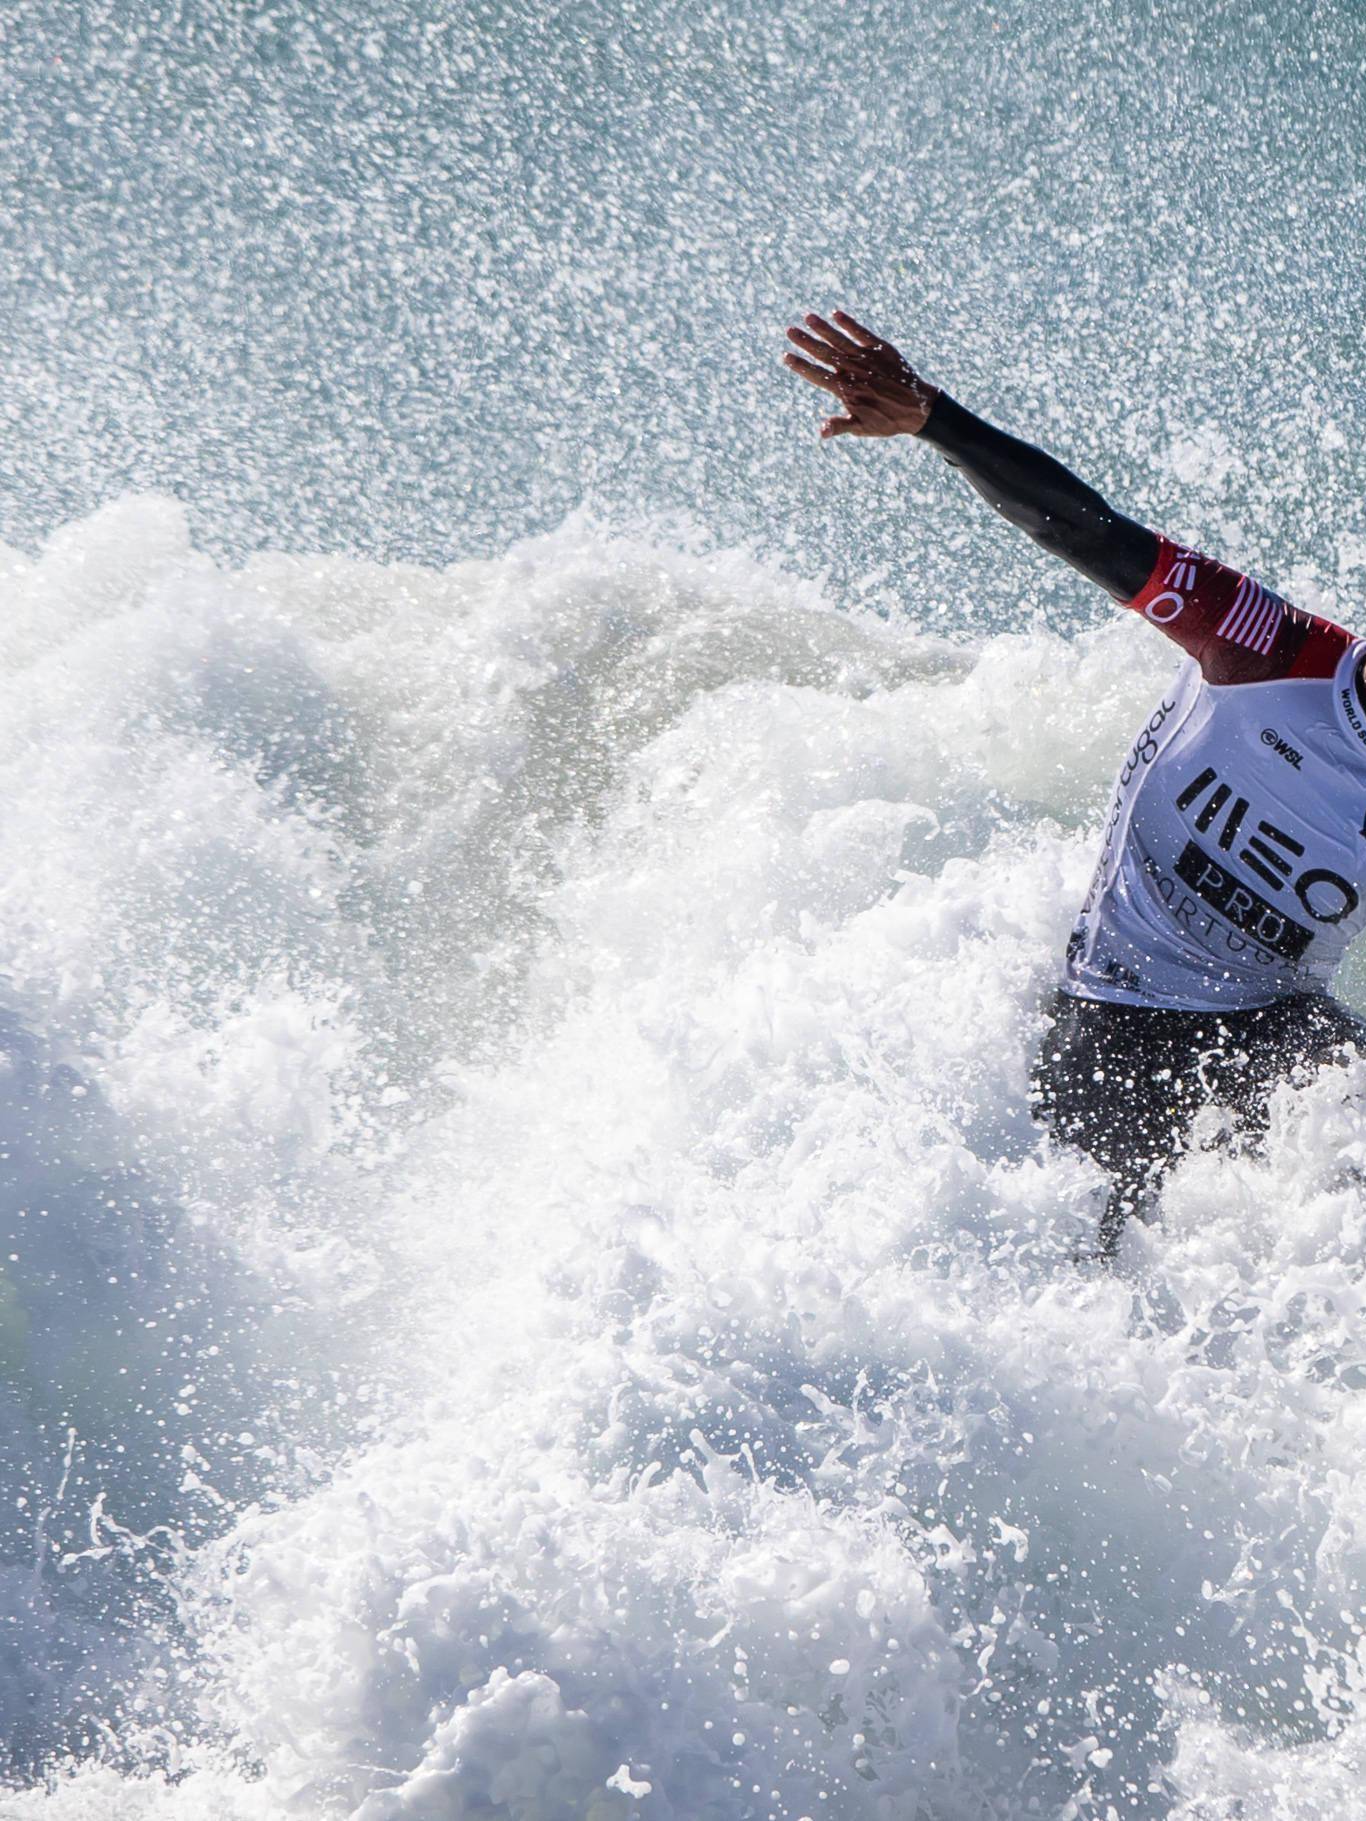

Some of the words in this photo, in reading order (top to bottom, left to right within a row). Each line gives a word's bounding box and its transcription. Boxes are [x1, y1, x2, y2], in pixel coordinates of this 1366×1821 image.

[1341, 688, 1362, 731] WORLD
[1273, 738, 1304, 771] WSL
[1176, 767, 1359, 924] MEO
[1196, 863, 1284, 942] PRO
